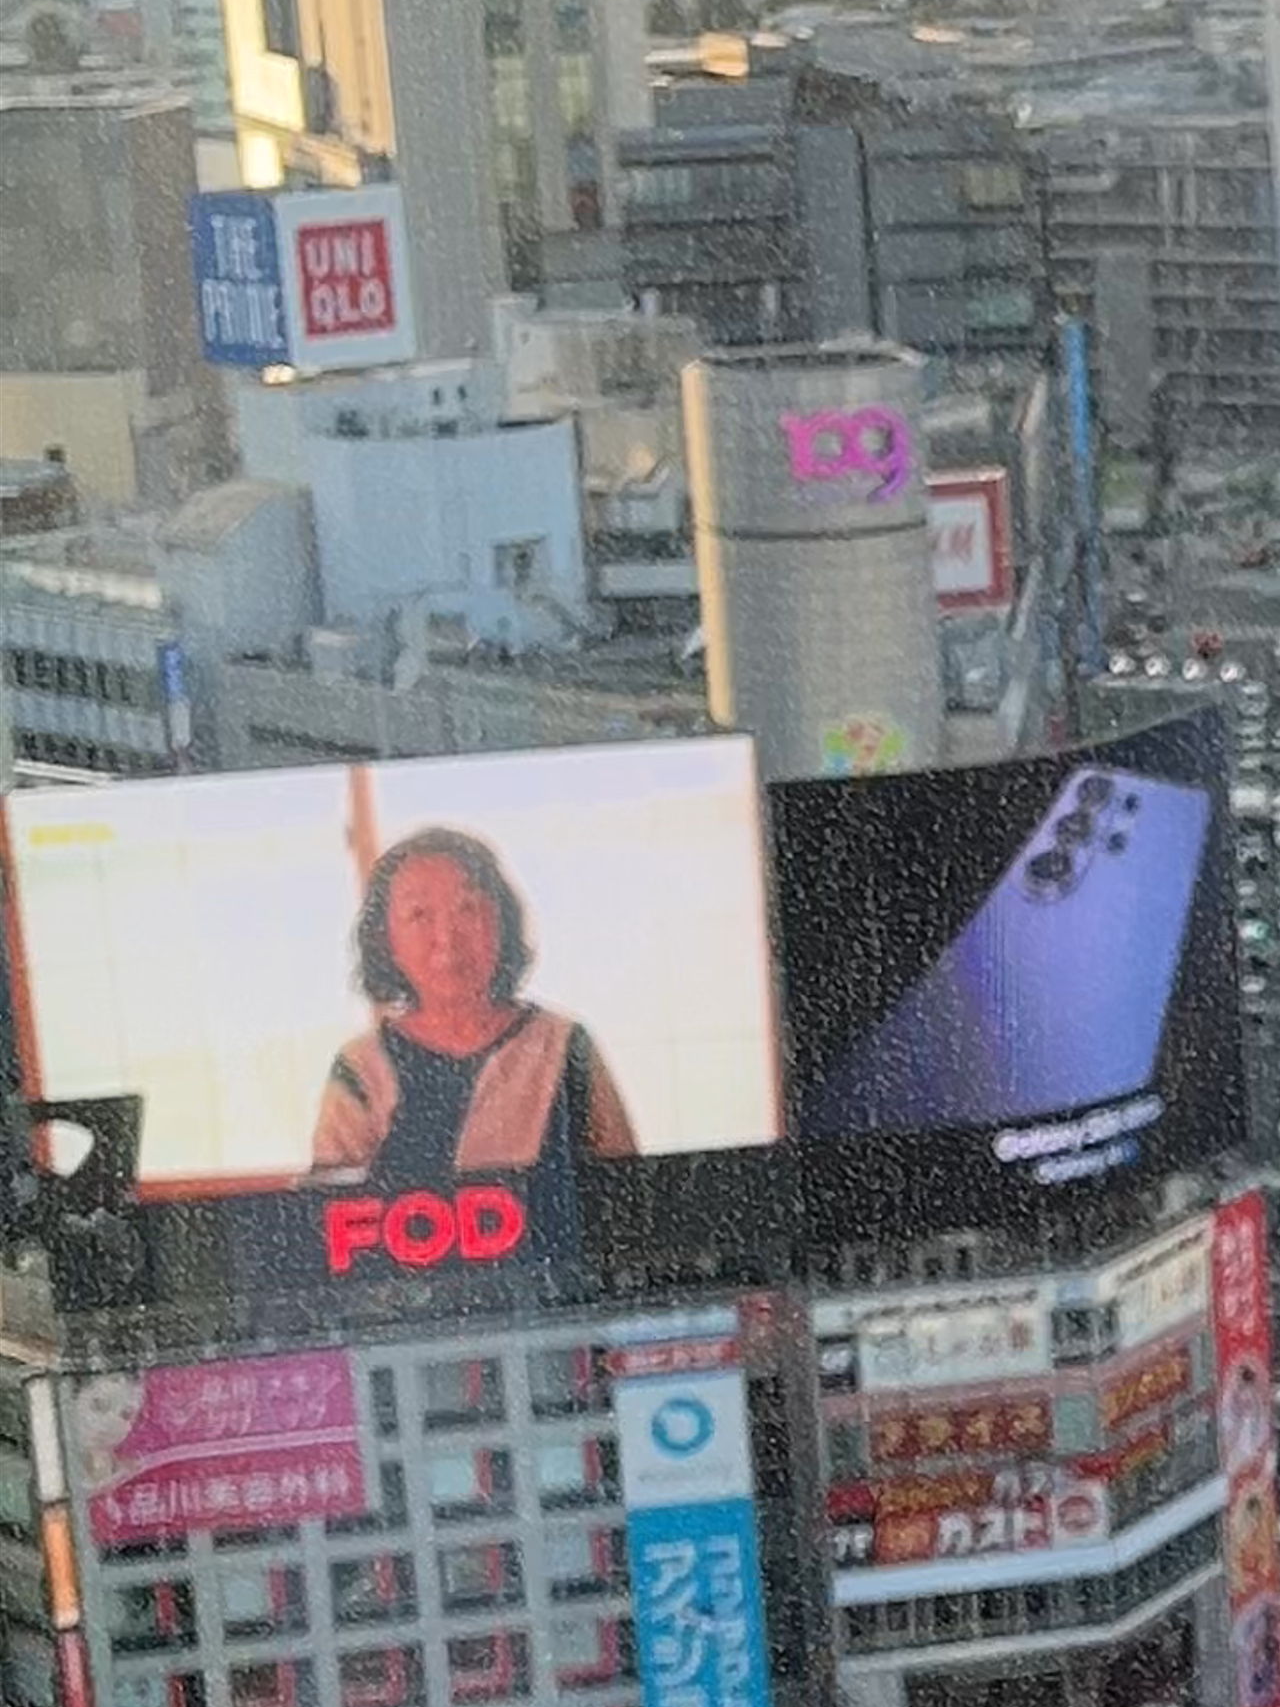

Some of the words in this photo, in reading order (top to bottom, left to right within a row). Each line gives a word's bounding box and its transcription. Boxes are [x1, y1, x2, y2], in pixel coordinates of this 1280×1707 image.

[211, 213, 262, 280] THE
[304, 230, 376, 278] UNI
[312, 277, 386, 333] QLO
[780, 405, 907, 504] 109
[323, 1185, 524, 1274] FOD
